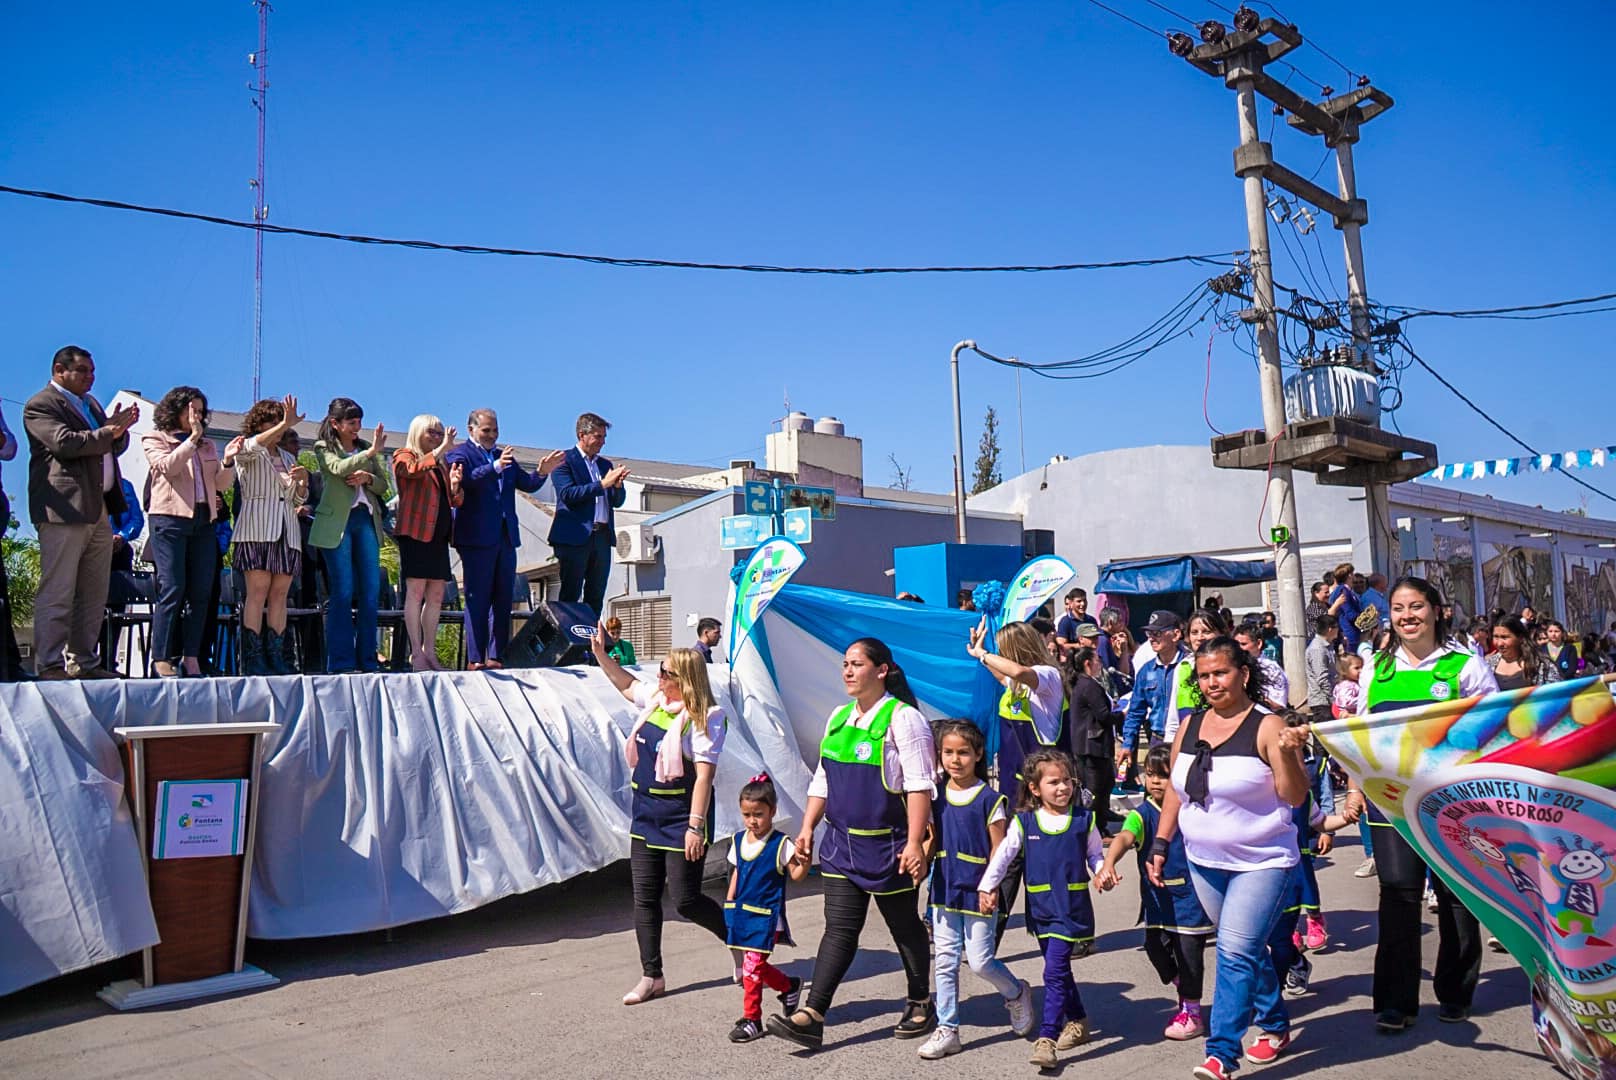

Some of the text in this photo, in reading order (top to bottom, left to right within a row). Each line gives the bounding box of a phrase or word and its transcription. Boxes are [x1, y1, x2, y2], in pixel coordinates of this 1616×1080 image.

[1437, 788, 1457, 804] DE
[1453, 780, 1521, 801] INFANTES
[1552, 792, 1584, 813] 202
[1495, 799, 1564, 823] PEDROSO
